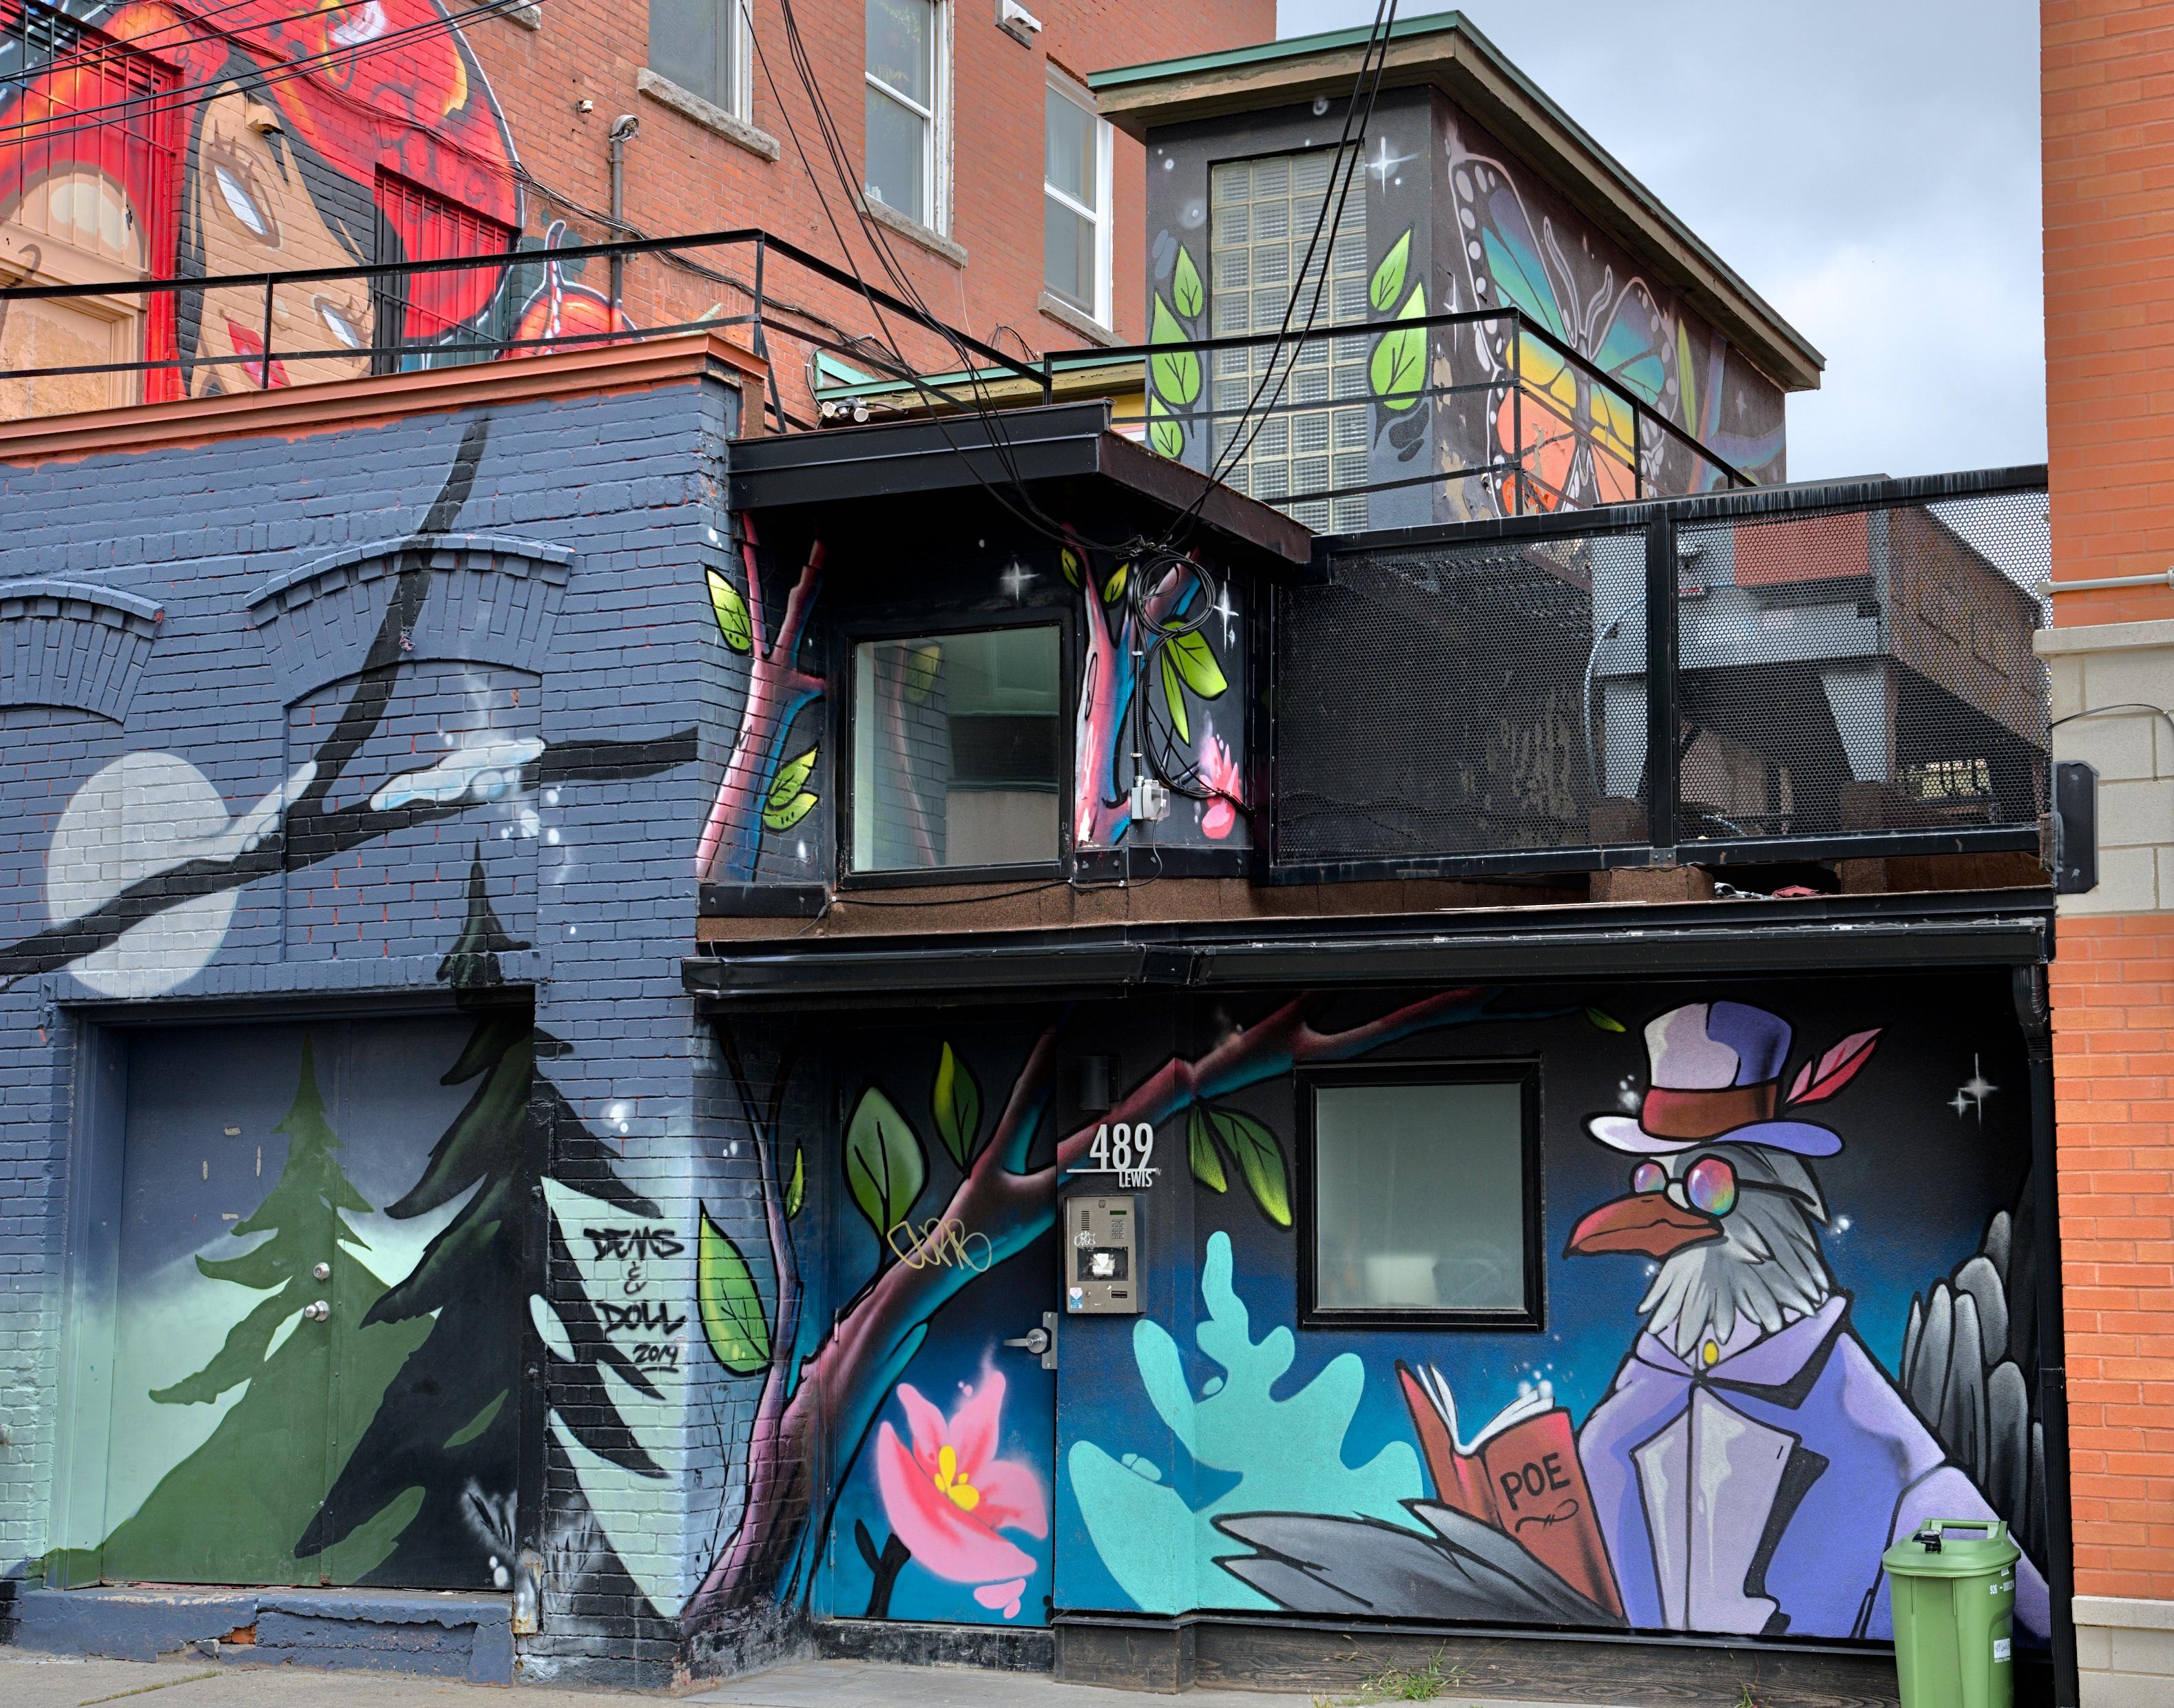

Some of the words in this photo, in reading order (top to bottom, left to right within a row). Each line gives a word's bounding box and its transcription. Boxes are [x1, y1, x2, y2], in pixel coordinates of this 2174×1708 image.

[1089, 1123, 1153, 1170] 489
[1118, 1171, 1153, 1187] LEWIS
[632, 1344, 678, 1366] 2019
[1500, 1452, 1571, 1510] POE
